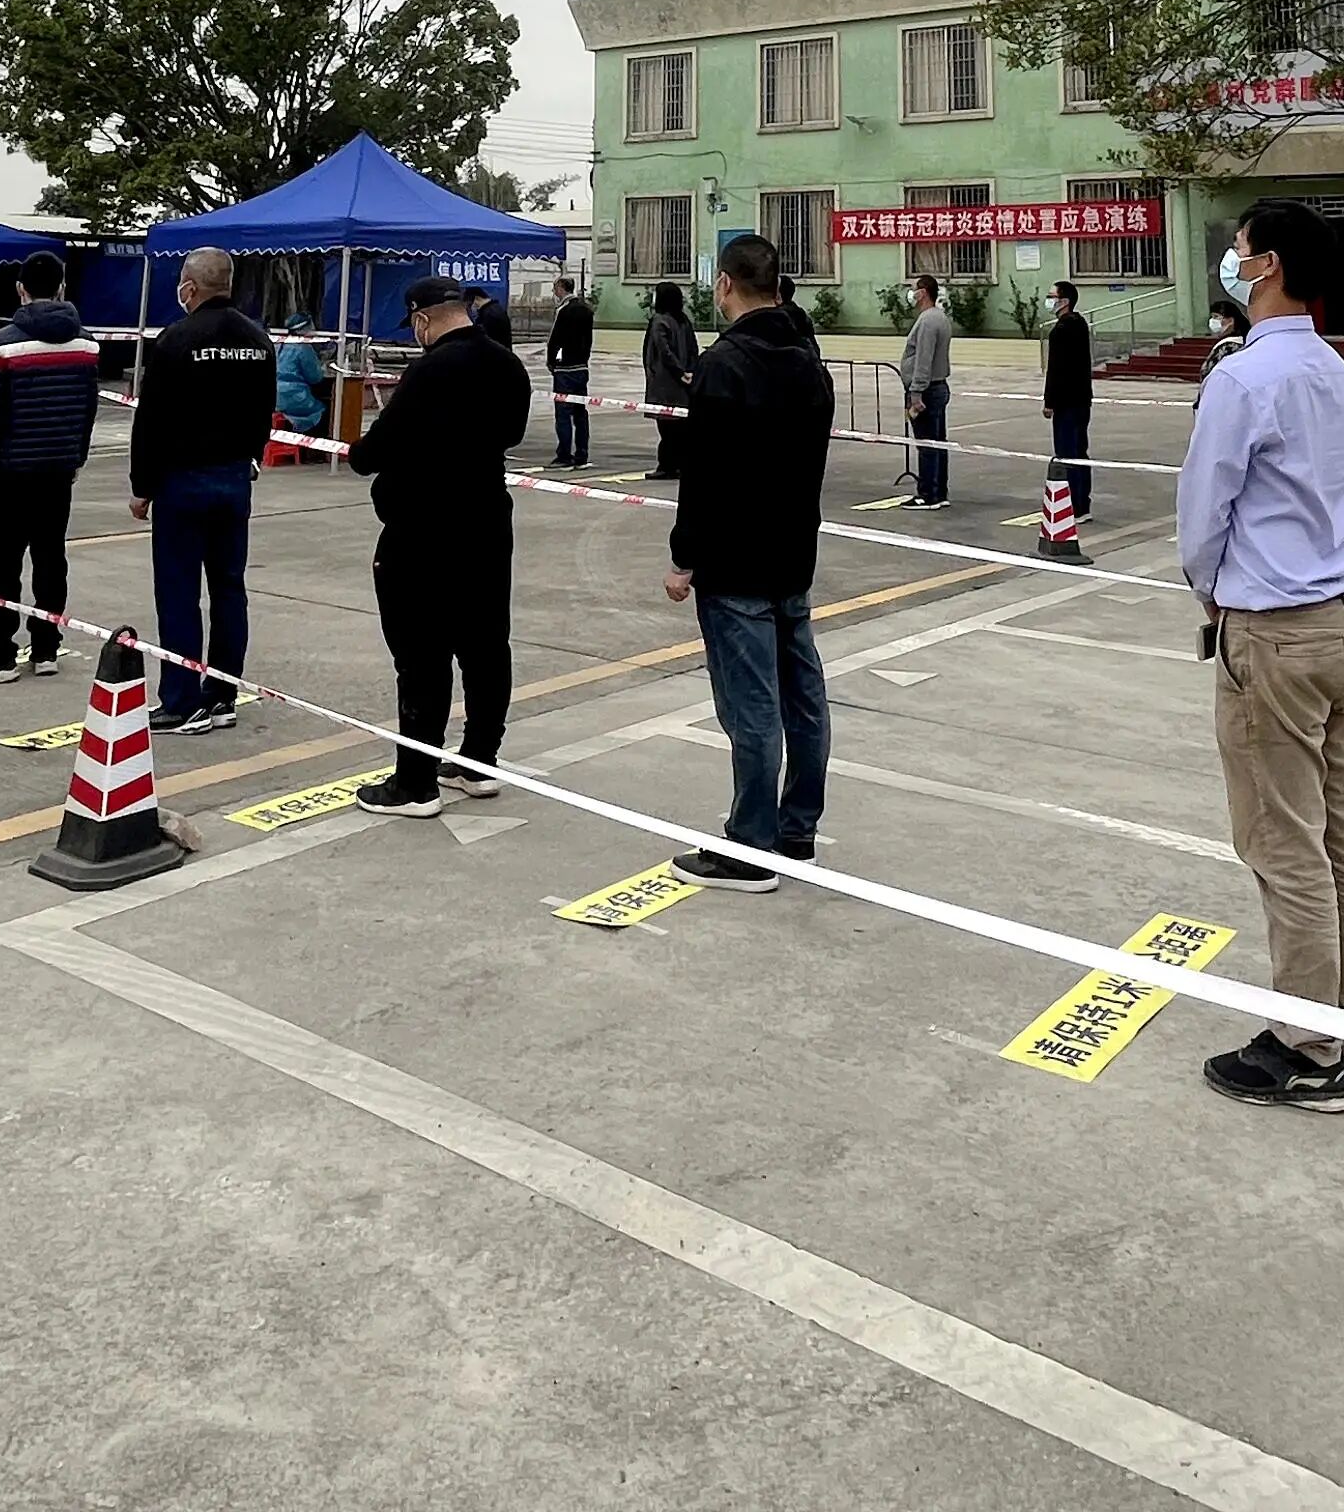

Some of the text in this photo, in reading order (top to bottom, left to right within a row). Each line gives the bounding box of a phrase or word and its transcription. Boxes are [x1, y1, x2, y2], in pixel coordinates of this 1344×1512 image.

[841, 205, 1148, 238] 双水镇新冠肺炎疫情处置应急演练
[438, 260, 501, 282] 信息核对区
[1026, 921, 1216, 1067] 请保持1米全距离
